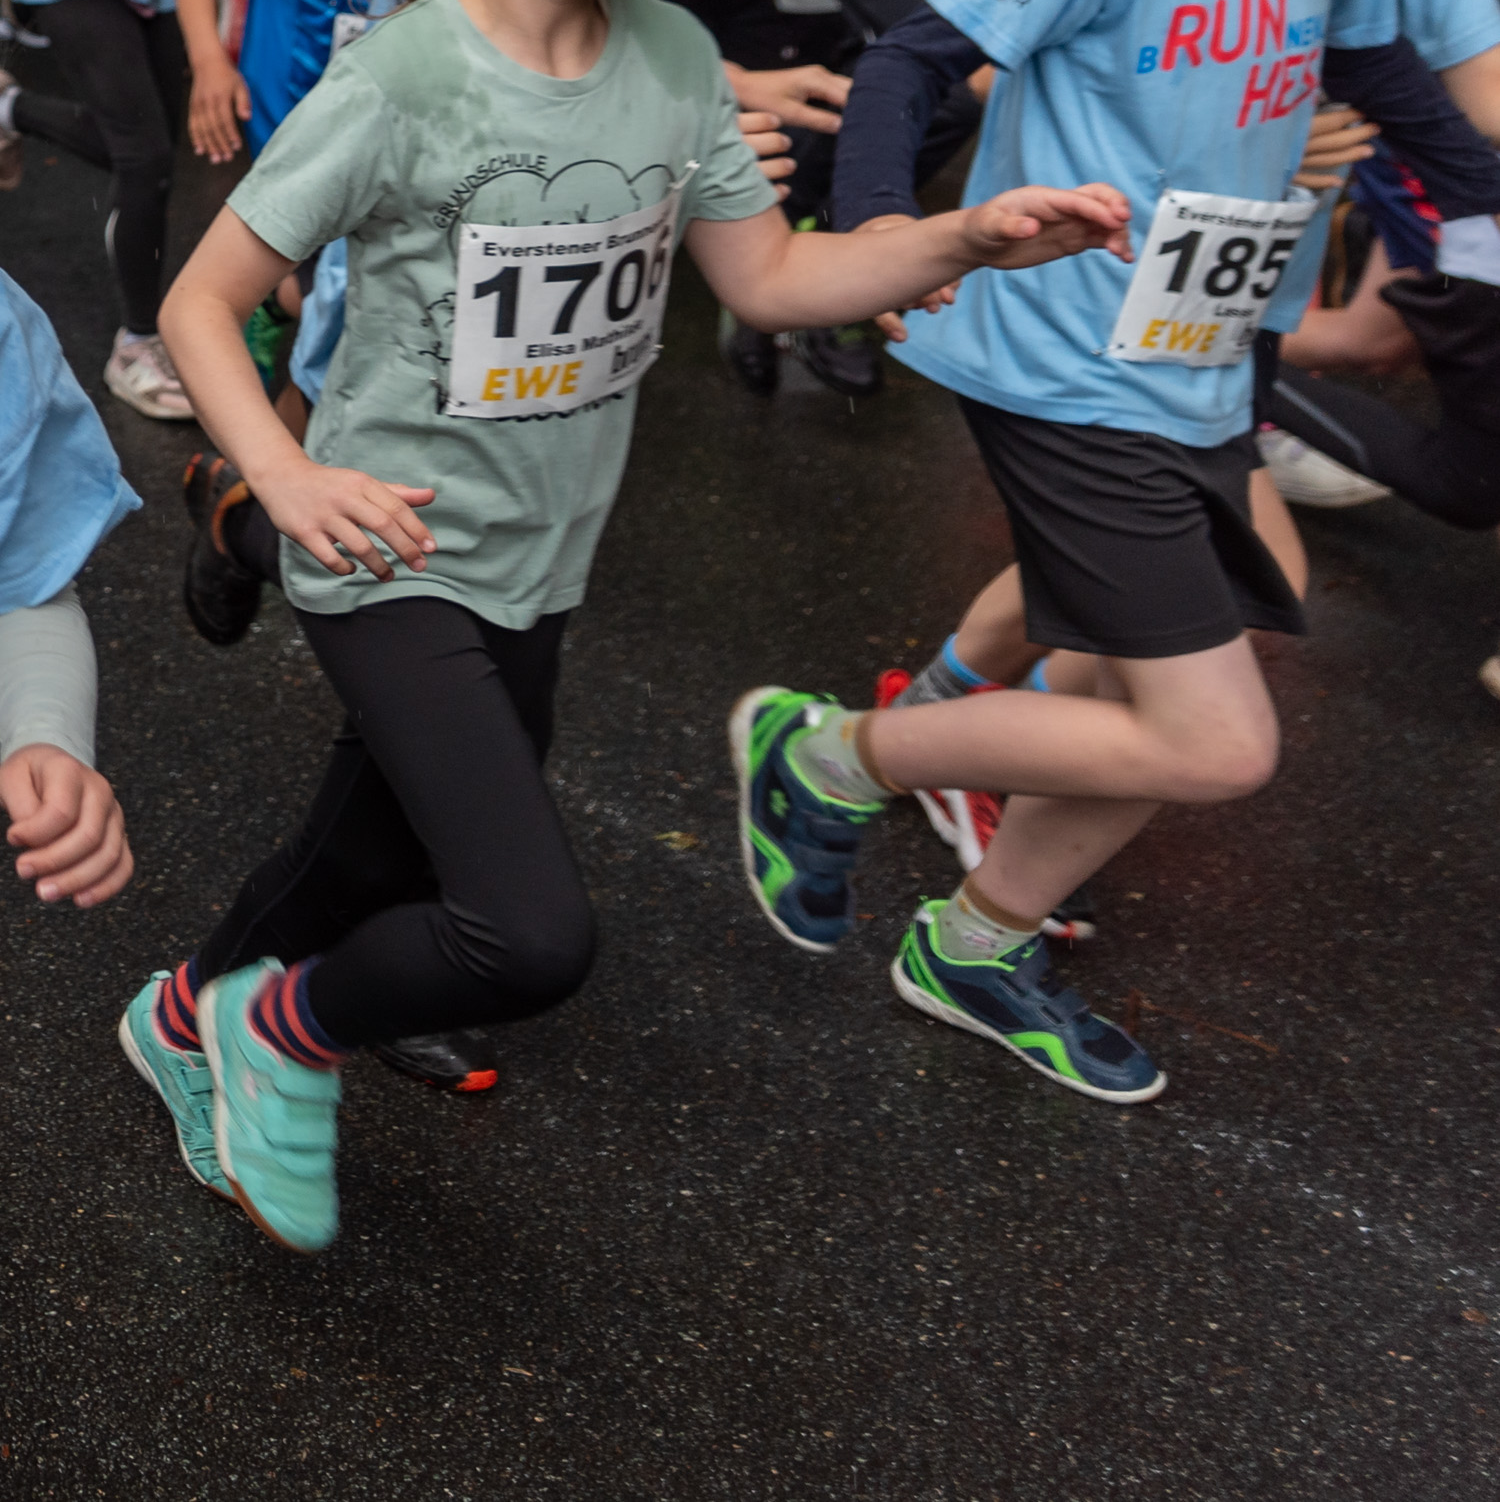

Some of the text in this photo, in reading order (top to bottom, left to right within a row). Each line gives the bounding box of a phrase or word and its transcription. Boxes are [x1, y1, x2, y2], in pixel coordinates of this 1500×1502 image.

[433, 153, 548, 230] GRUNDSCHULE
[483, 239, 602, 258] Everstener
[526, 343, 577, 359] Elisa
[1139, 319, 1222, 354] EWE
[482, 360, 584, 402] EWE
